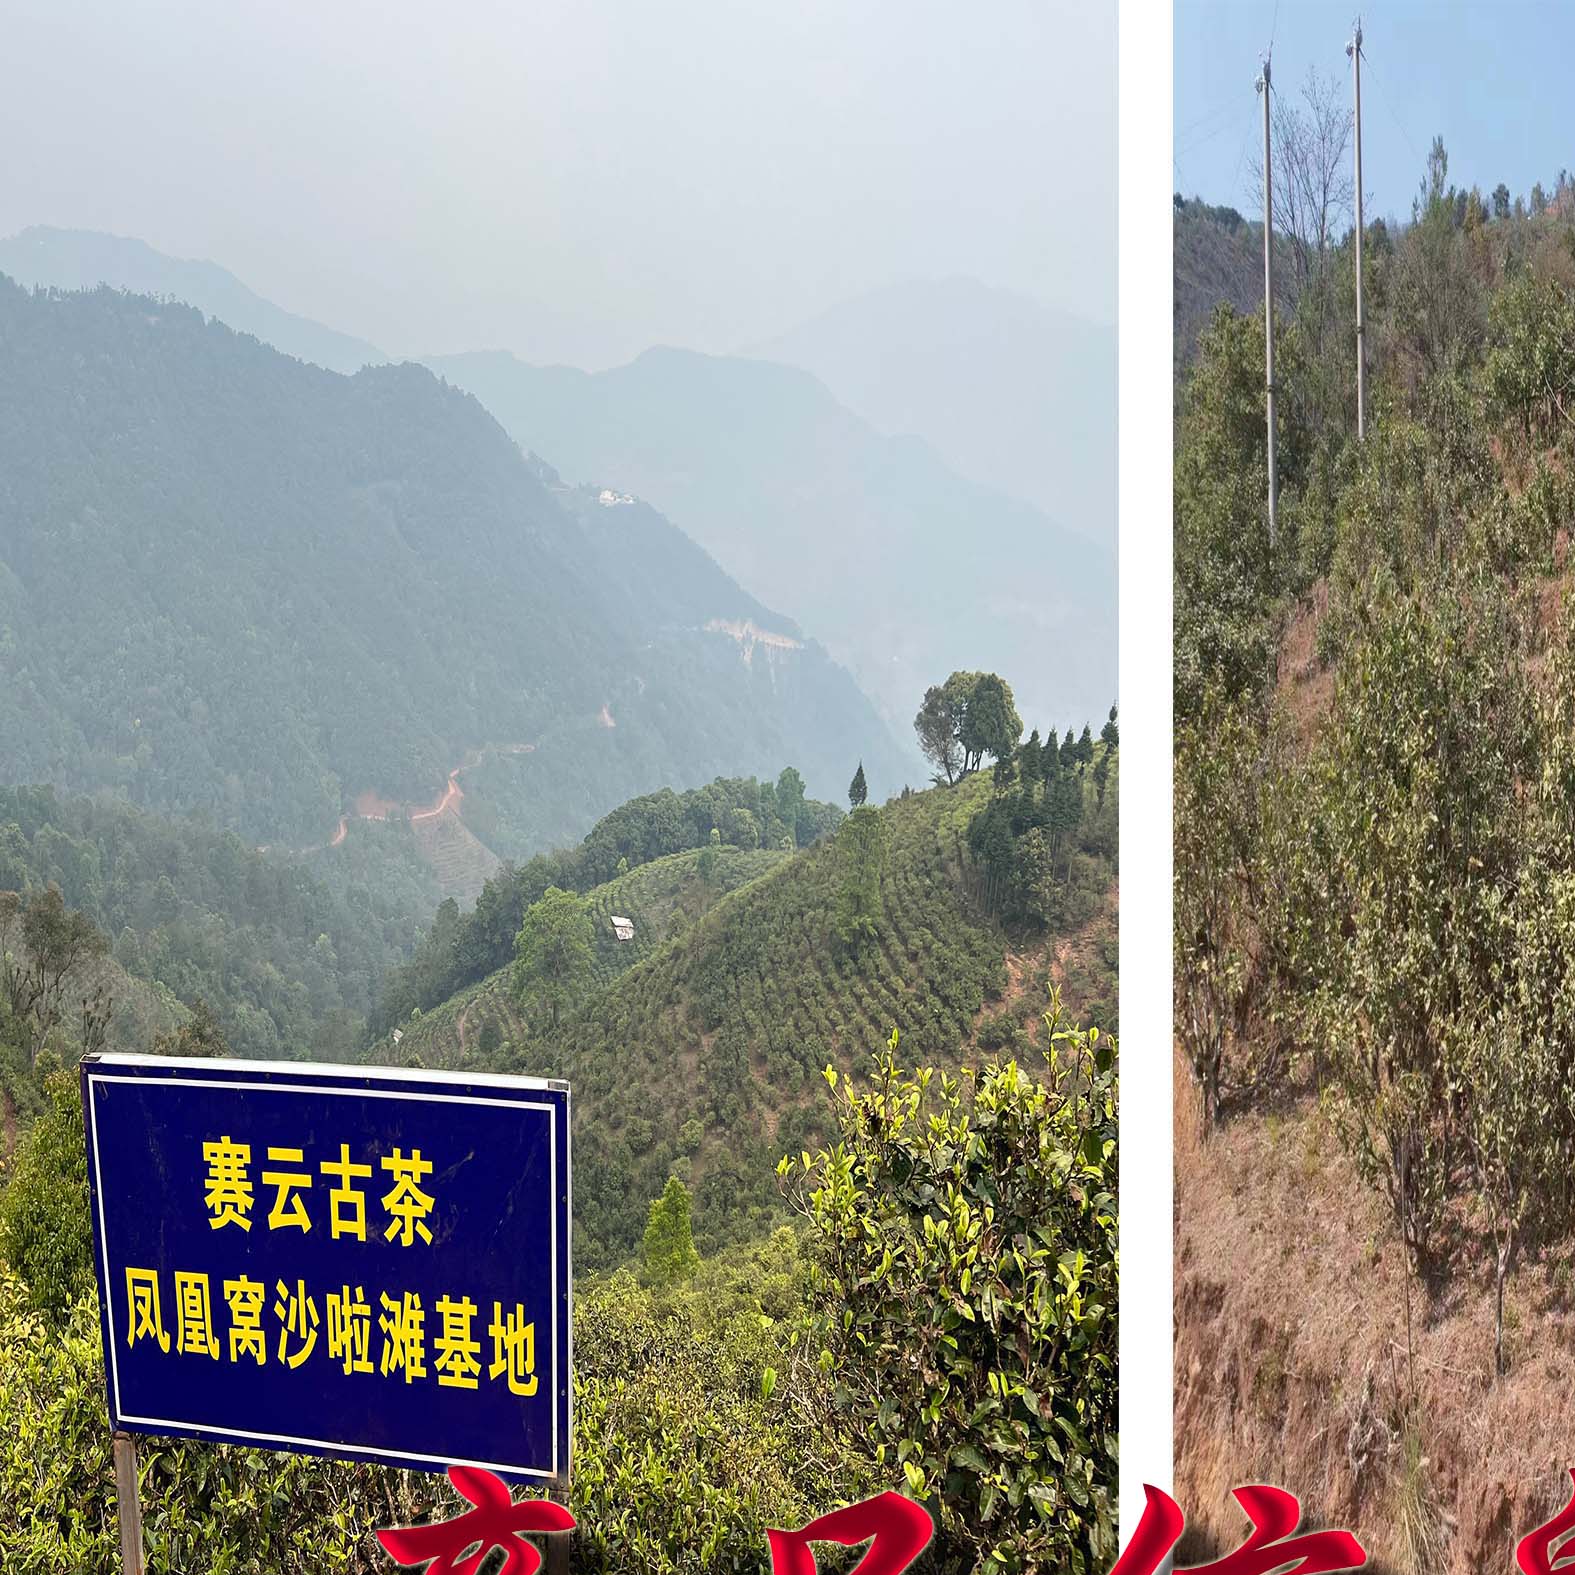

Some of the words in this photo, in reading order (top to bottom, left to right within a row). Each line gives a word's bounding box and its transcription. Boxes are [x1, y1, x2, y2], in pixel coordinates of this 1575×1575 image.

[202, 1136, 436, 1247] 赛云古茶
[125, 1267, 539, 1397] 凤凰窝沙啦滩基地
